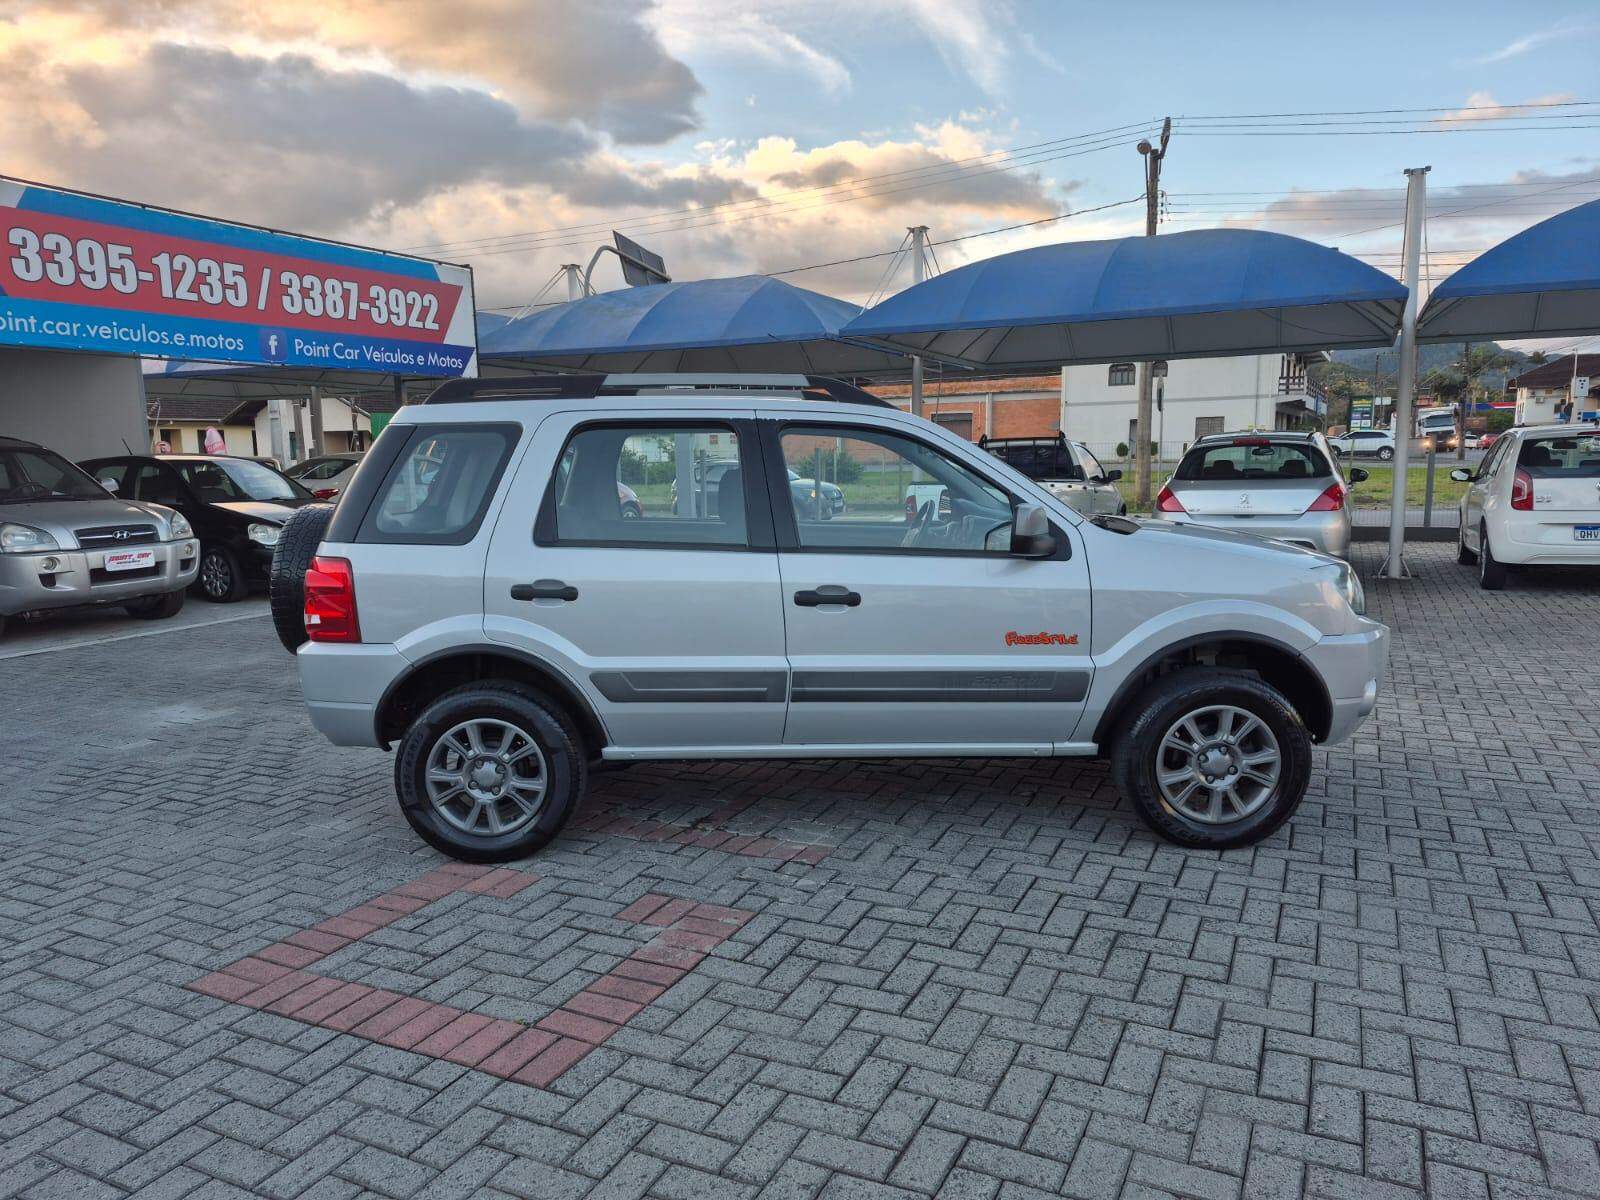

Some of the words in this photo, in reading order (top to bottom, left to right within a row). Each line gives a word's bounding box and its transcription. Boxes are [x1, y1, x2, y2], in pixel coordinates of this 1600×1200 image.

[8, 226, 248, 308] 3395-1235
[280, 271, 440, 331] 3387-3922
[294, 338, 329, 358] Point
[333, 343, 359, 360] Car
[363, 346, 414, 364] Veículos
[416, 356, 424, 365] e
[427, 355, 463, 369] Motos
